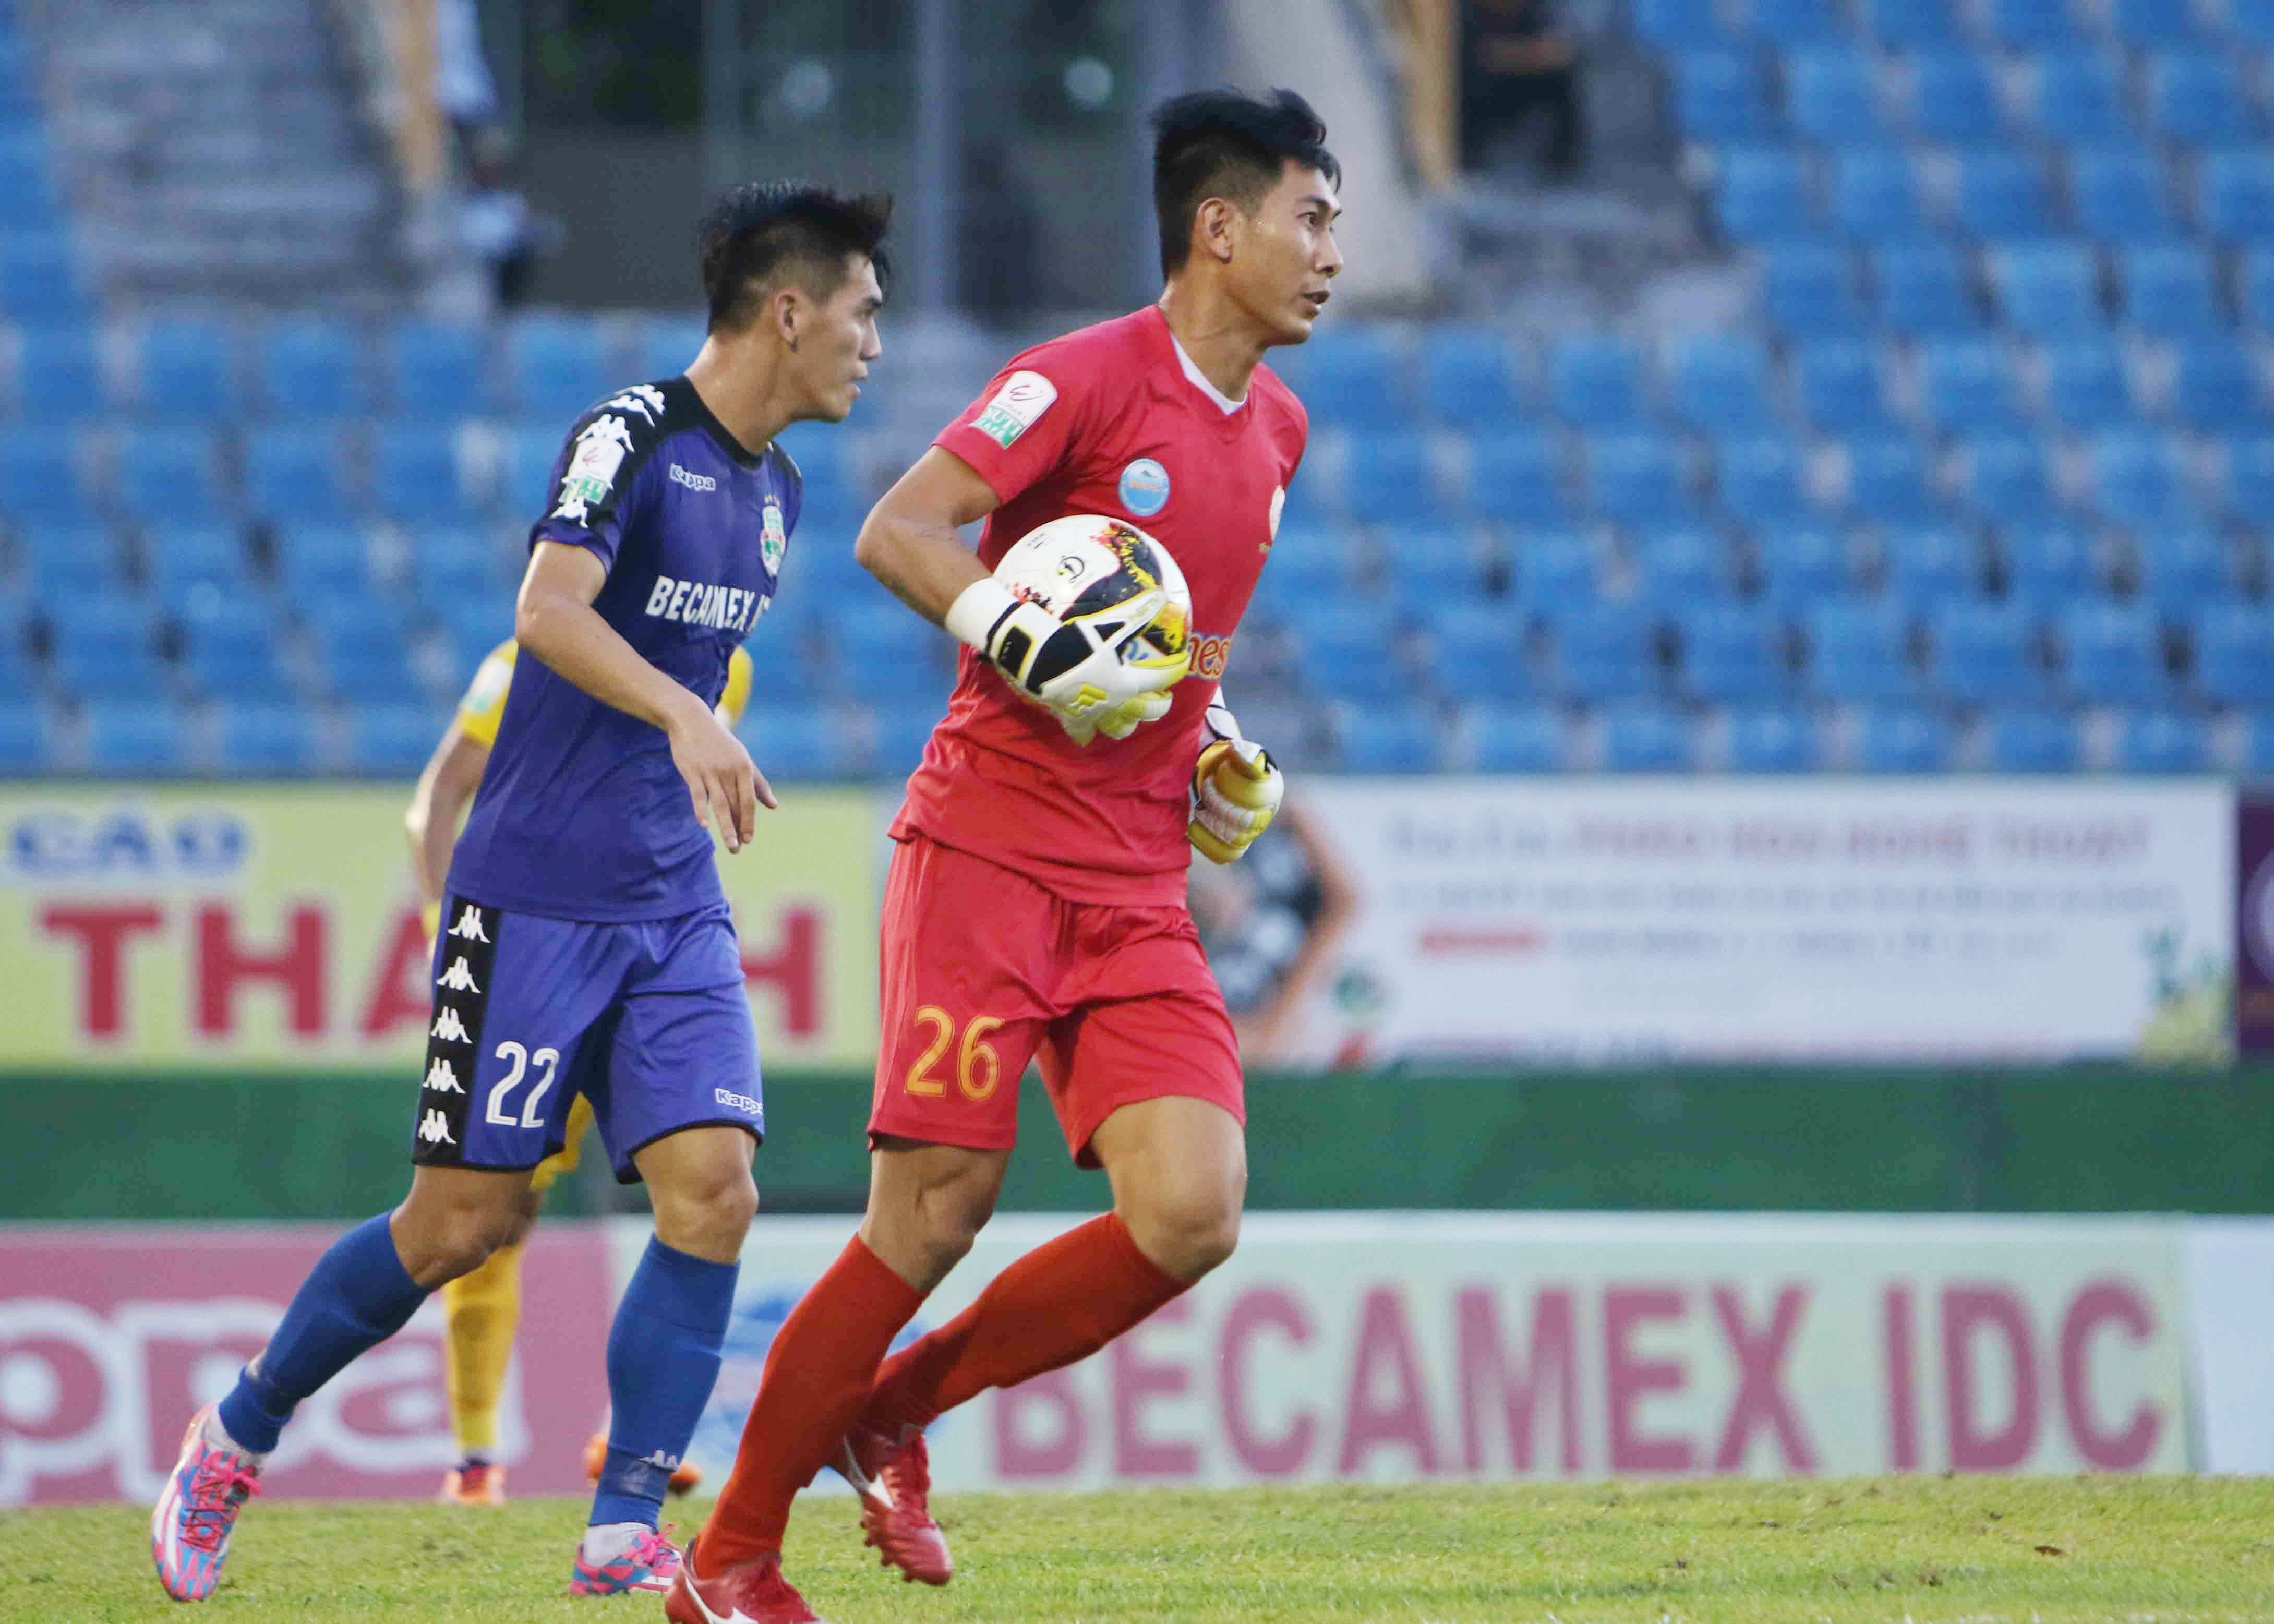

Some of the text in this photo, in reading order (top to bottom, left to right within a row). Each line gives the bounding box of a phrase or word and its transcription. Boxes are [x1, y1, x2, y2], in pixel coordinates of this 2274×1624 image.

[644, 574, 756, 632] BECAMEX
[485, 1041, 560, 1128] 22
[904, 1004, 1005, 1102] 26
[1882, 1279, 2166, 1475] IDC
